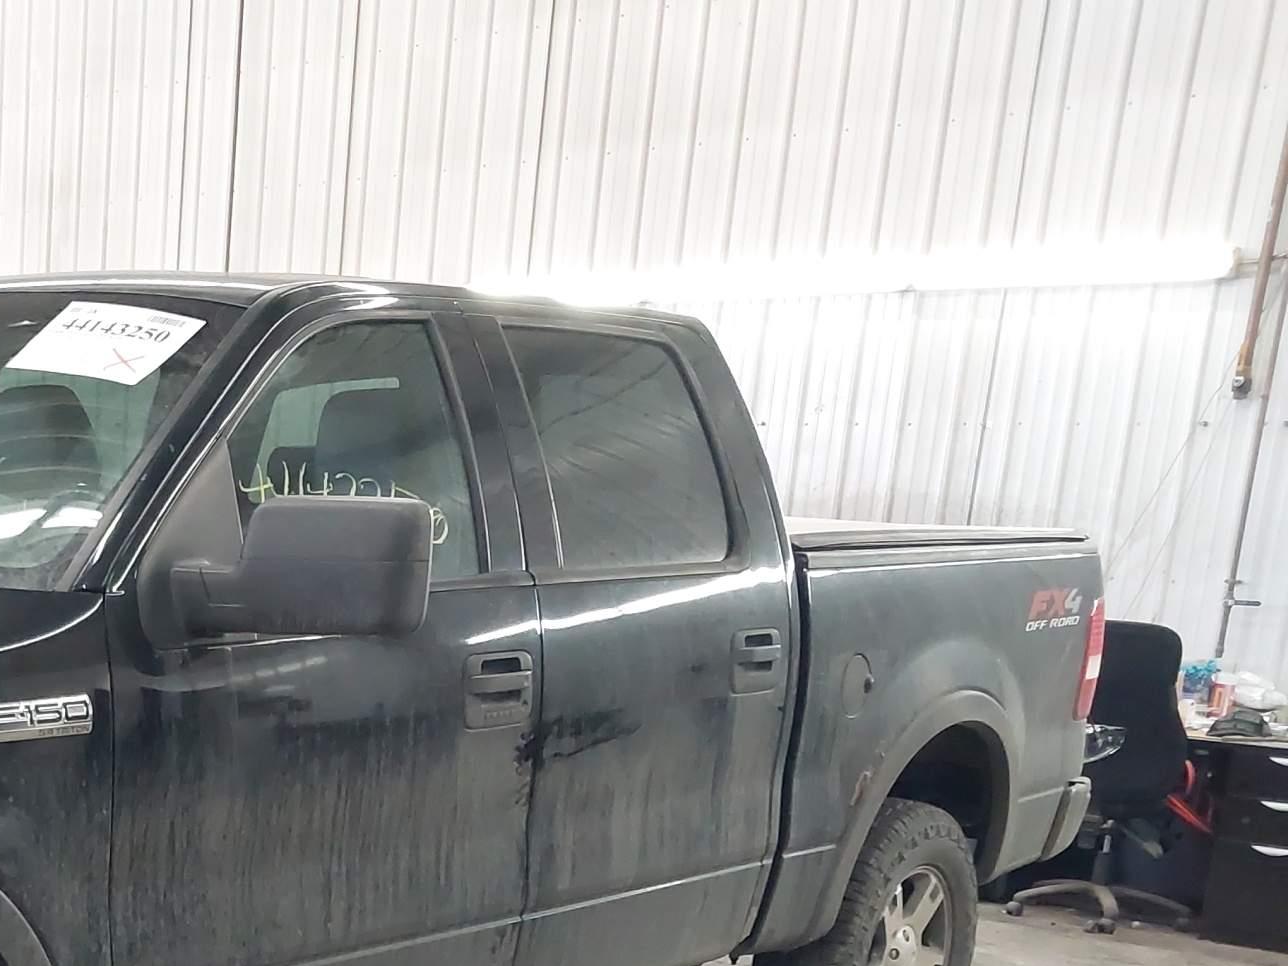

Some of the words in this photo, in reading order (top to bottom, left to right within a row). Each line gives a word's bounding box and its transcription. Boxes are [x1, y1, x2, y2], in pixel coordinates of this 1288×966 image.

[63, 308, 171, 343] 44143250
[1029, 588, 1082, 619] FX4
[1025, 619, 1048, 631] OFF
[1049, 615, 1080, 628] ROAD
